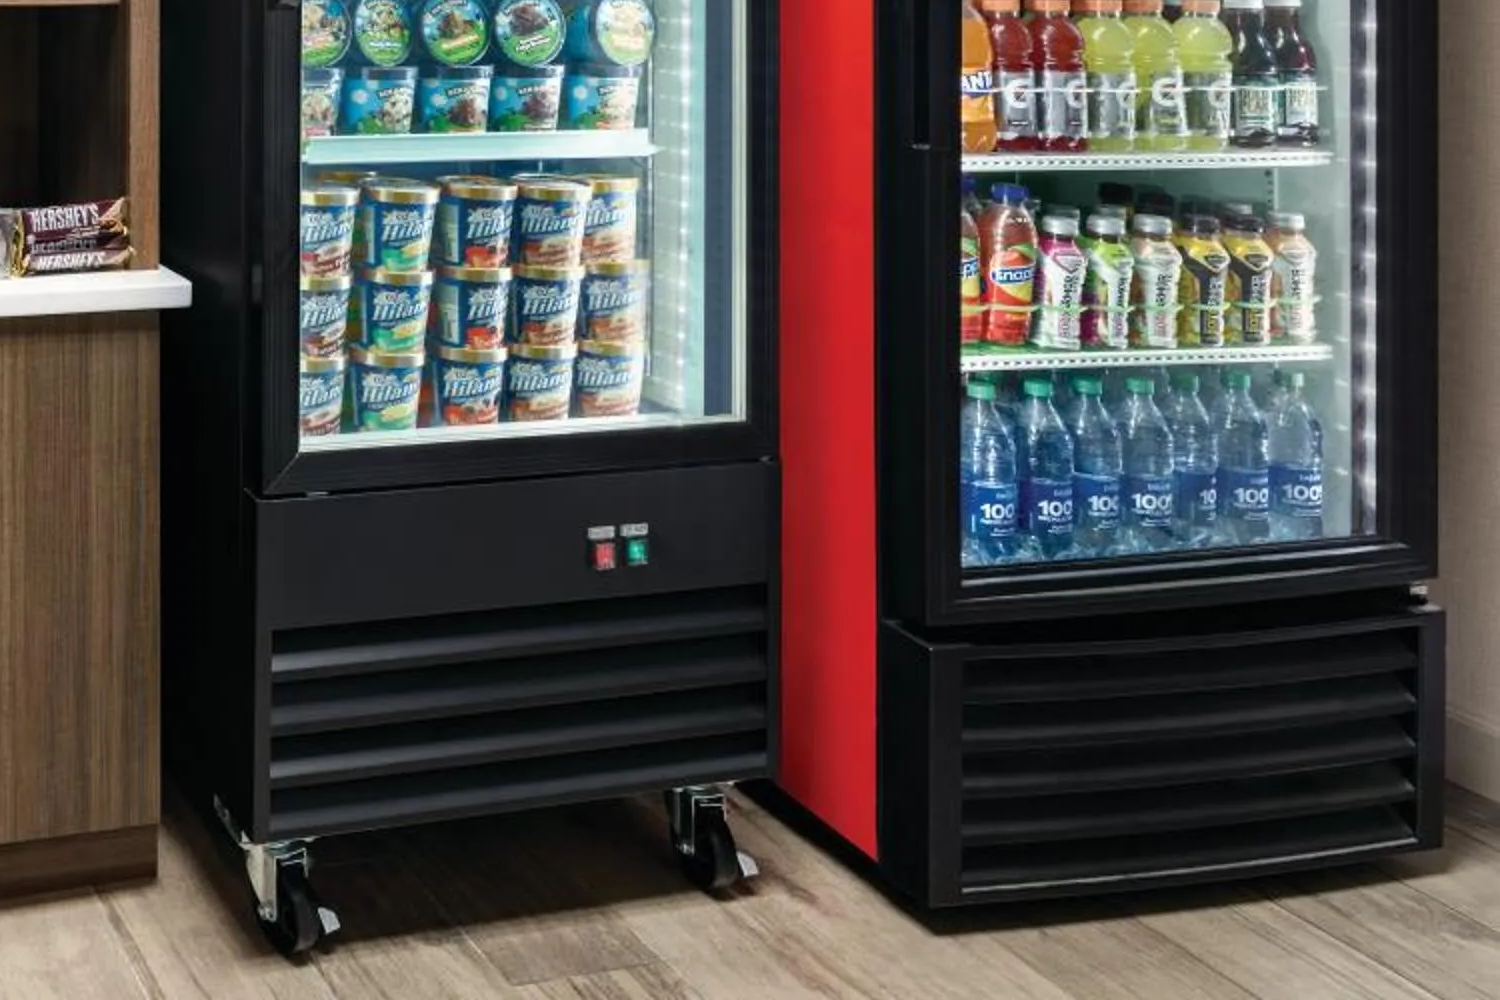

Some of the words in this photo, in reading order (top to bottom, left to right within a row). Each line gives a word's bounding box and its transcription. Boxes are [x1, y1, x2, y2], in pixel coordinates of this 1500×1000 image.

[30, 202, 100, 233] HERSHEY'S
[37, 252, 106, 271] HERSHEY'S
[1200, 488, 1217, 504] 10
[1233, 487, 1269, 504] 100
[1037, 500, 1073, 516] 100
